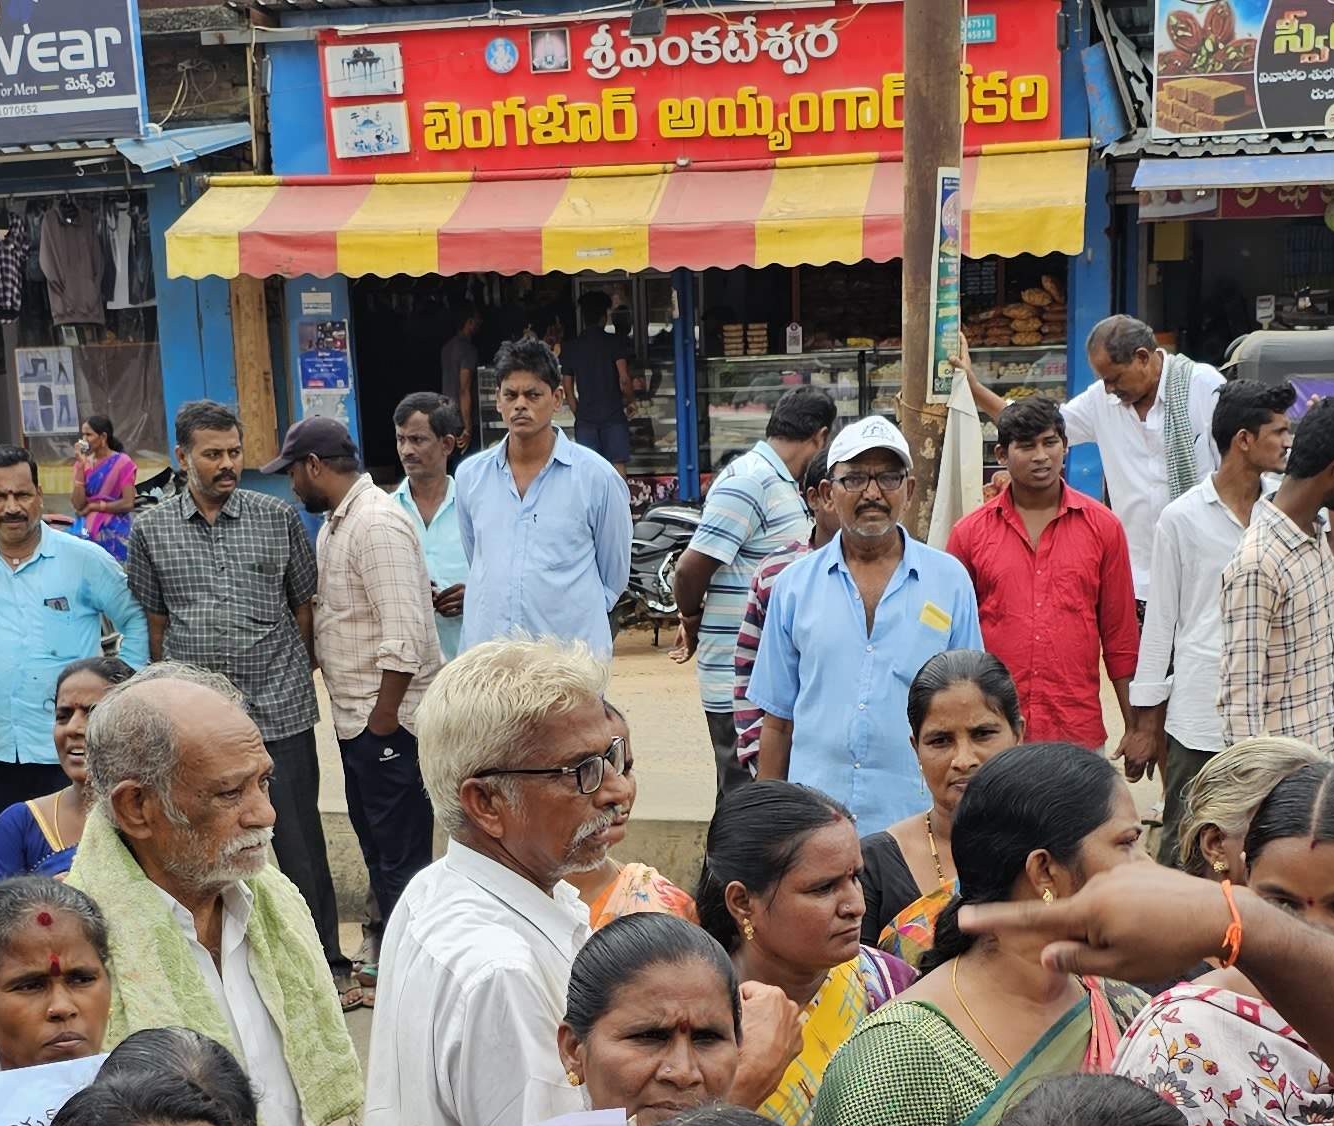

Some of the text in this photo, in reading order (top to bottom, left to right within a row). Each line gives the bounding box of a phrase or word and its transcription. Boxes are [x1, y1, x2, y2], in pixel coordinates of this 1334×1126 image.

[13, 84, 38, 96] Men
[423, 86, 638, 151] బెంగళూర్
[959, 63, 1049, 125] కరి
